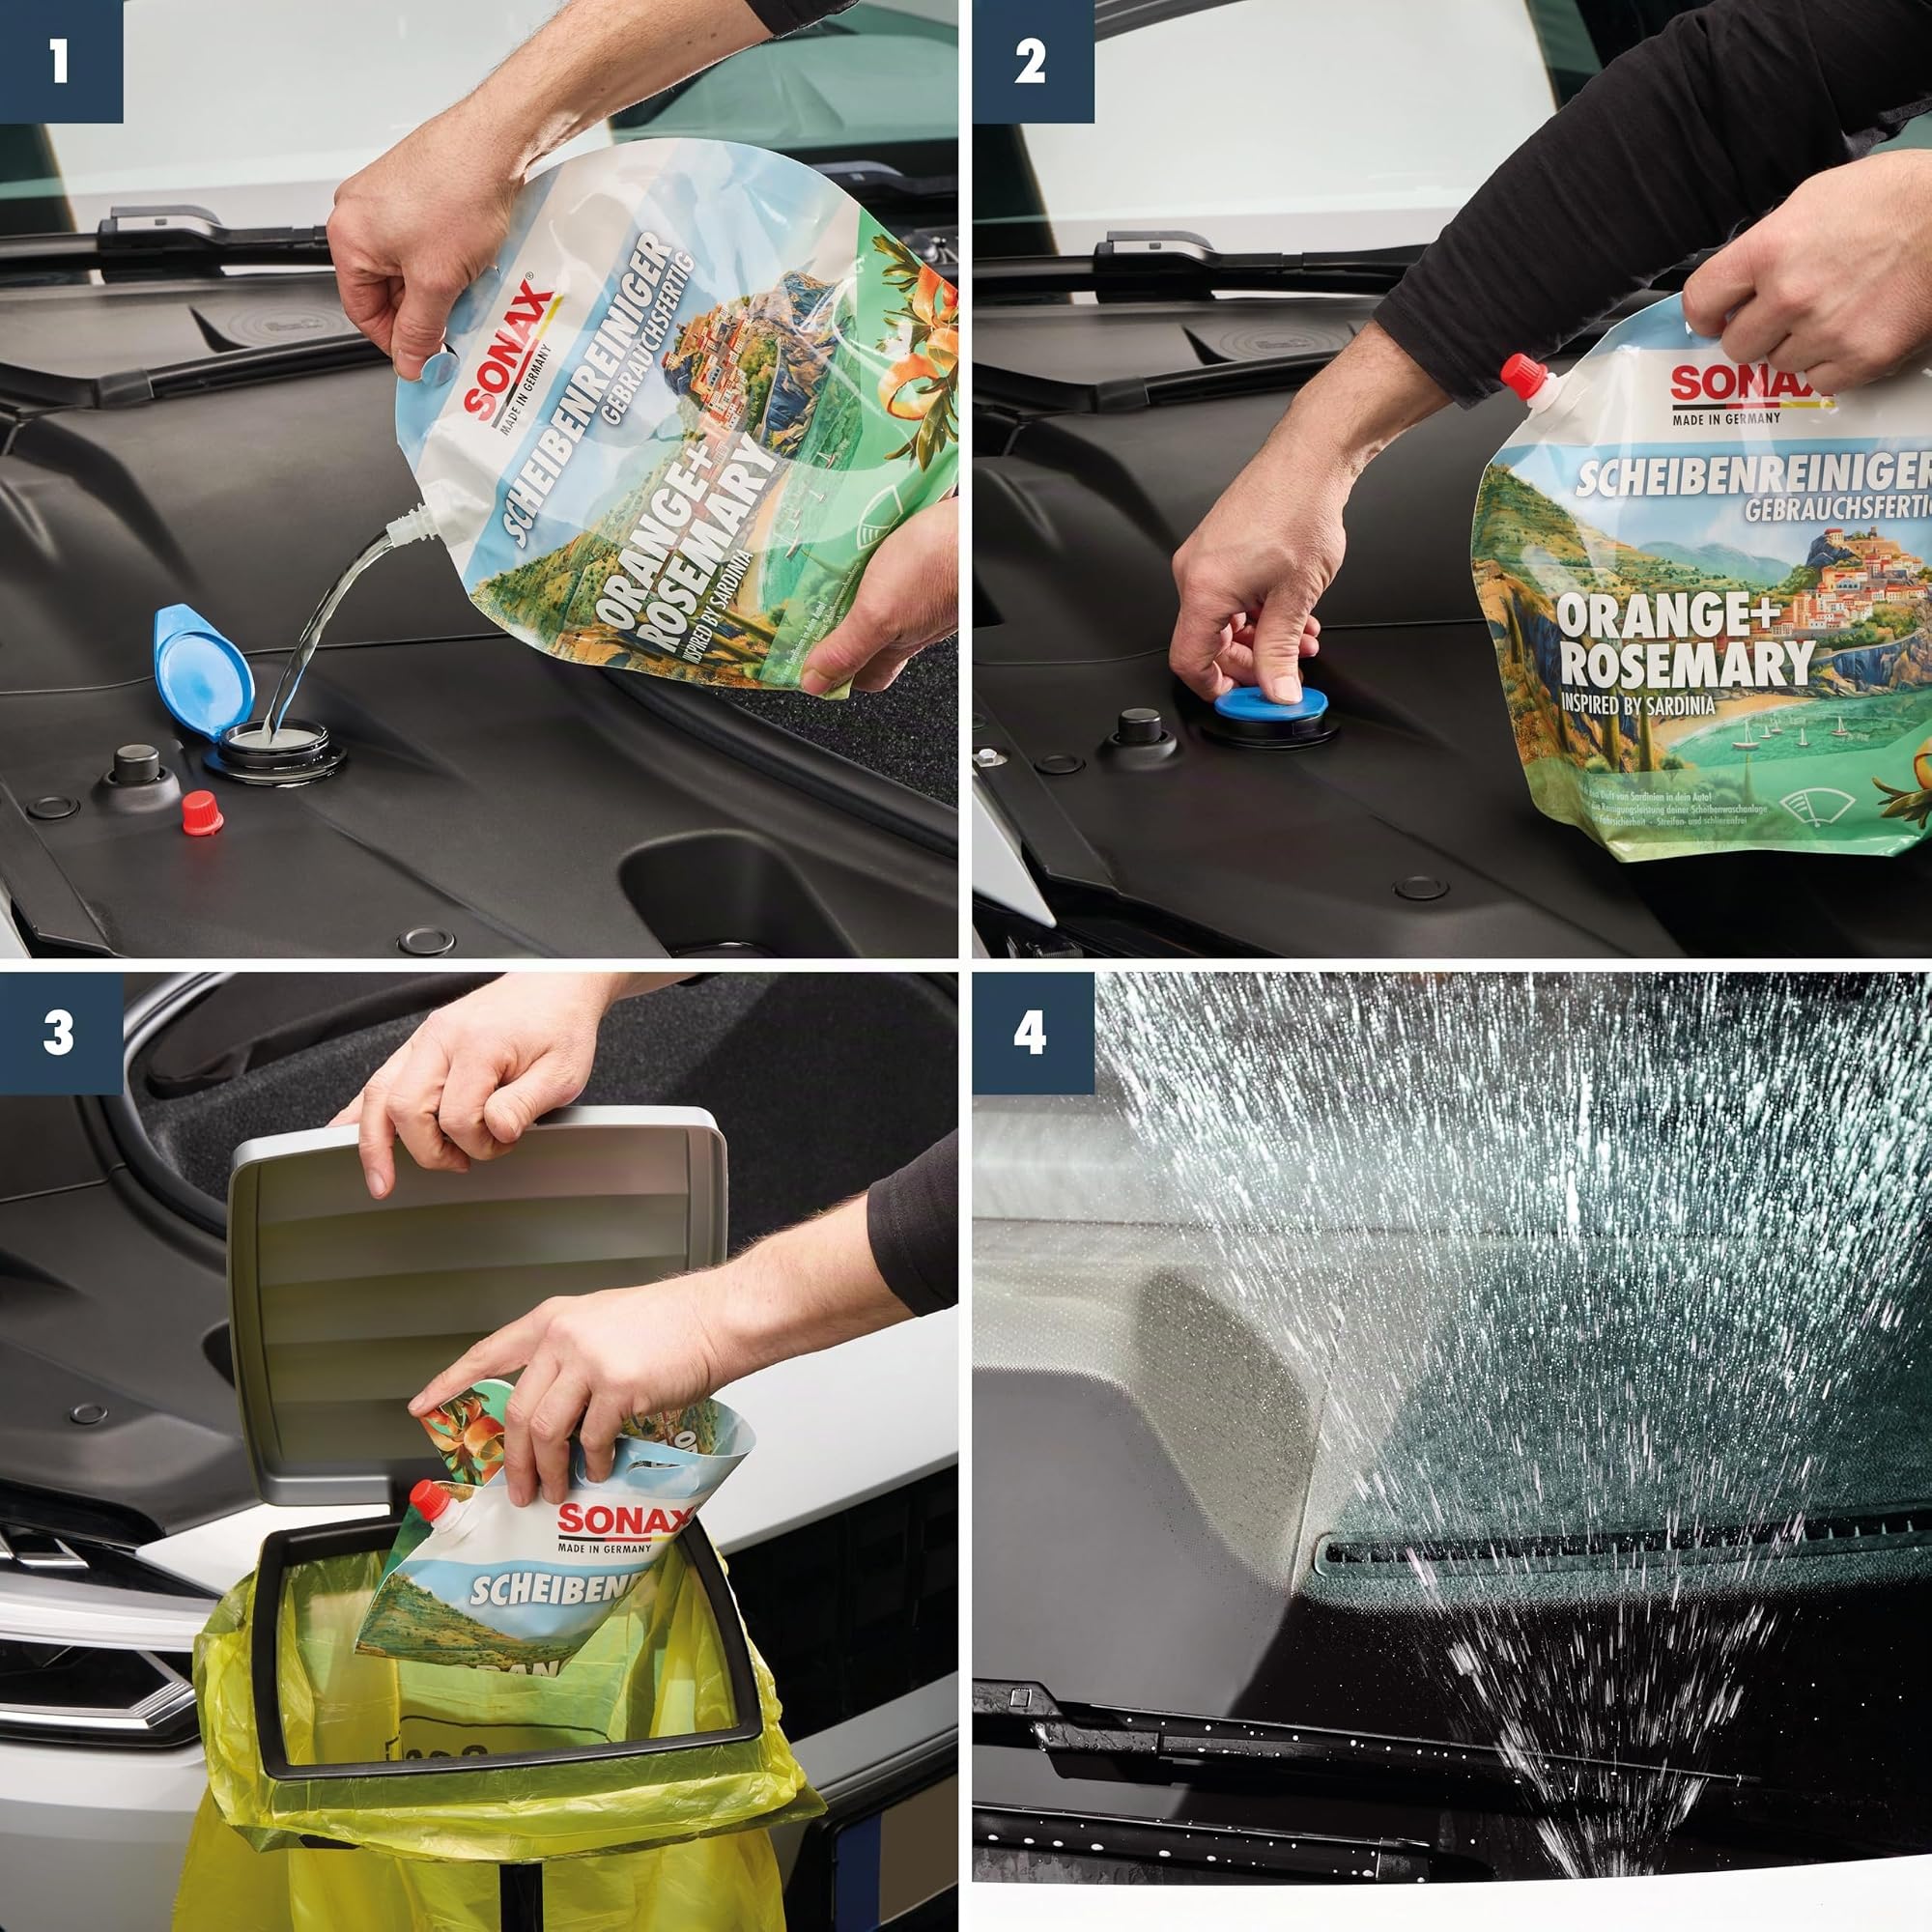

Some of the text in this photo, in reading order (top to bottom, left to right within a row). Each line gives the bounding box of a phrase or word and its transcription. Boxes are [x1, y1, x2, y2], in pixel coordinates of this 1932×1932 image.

[464, 278, 554, 421] SONAX
[601, 252, 696, 427] GEBRAUCHSFERTIG
[499, 343, 552, 437] MADE IN GERMANY
[501, 231, 674, 549] SCHEIBENREINIGER
[1670, 363, 1836, 401] SONA
[1672, 412, 1781, 426] MADE IN GERMANY
[1745, 494, 1932, 524] GEBRAUCHSFERTI
[595, 440, 714, 631] ORANGE+
[637, 432, 781, 654] ROSEMARY
[682, 549, 753, 665] INSPIRED BY SARDINIA
[1555, 590, 1781, 639] ORANGE+
[1559, 639, 1817, 691] ROSEMARY
[1561, 692, 1717, 717] INSPIRED BY SARDINIA
[1631, 790, 1664, 803] Sardinien
[1674, 790, 1691, 802] dein
[1692, 791, 1713, 803] Auto!
[1690, 803, 1768, 815] Scheibenwaschanlage
[557, 1502, 696, 1535] SONAX
[557, 1543, 652, 1554] MADE IN GERMANY
